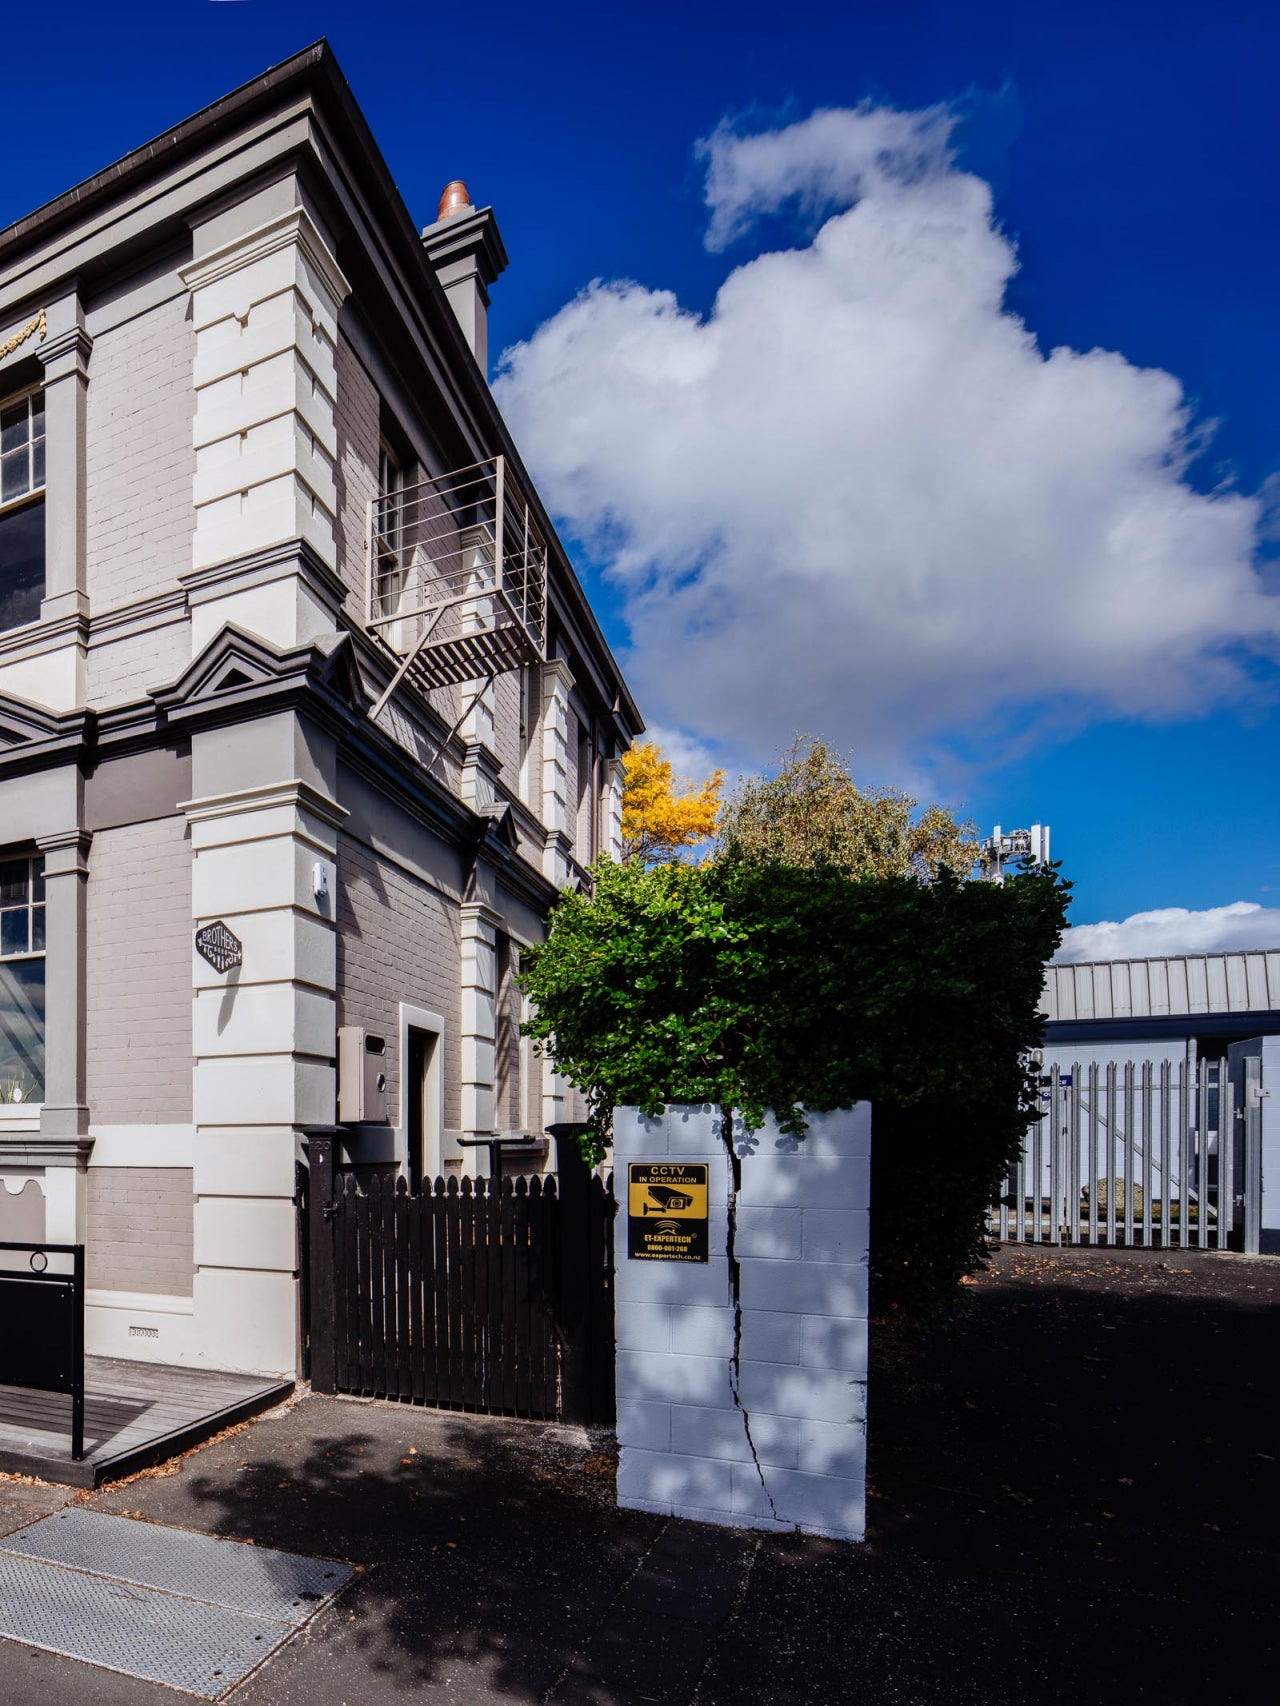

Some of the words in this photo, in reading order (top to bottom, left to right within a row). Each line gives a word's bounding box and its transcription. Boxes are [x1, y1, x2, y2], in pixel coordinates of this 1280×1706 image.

[202, 926, 237, 952] BROTHERS
[651, 1167, 684, 1175] CCTV
[644, 1235, 691, 1243] ET-EXPERTECH
[635, 1252, 701, 1260] www.expertech.co.nz
